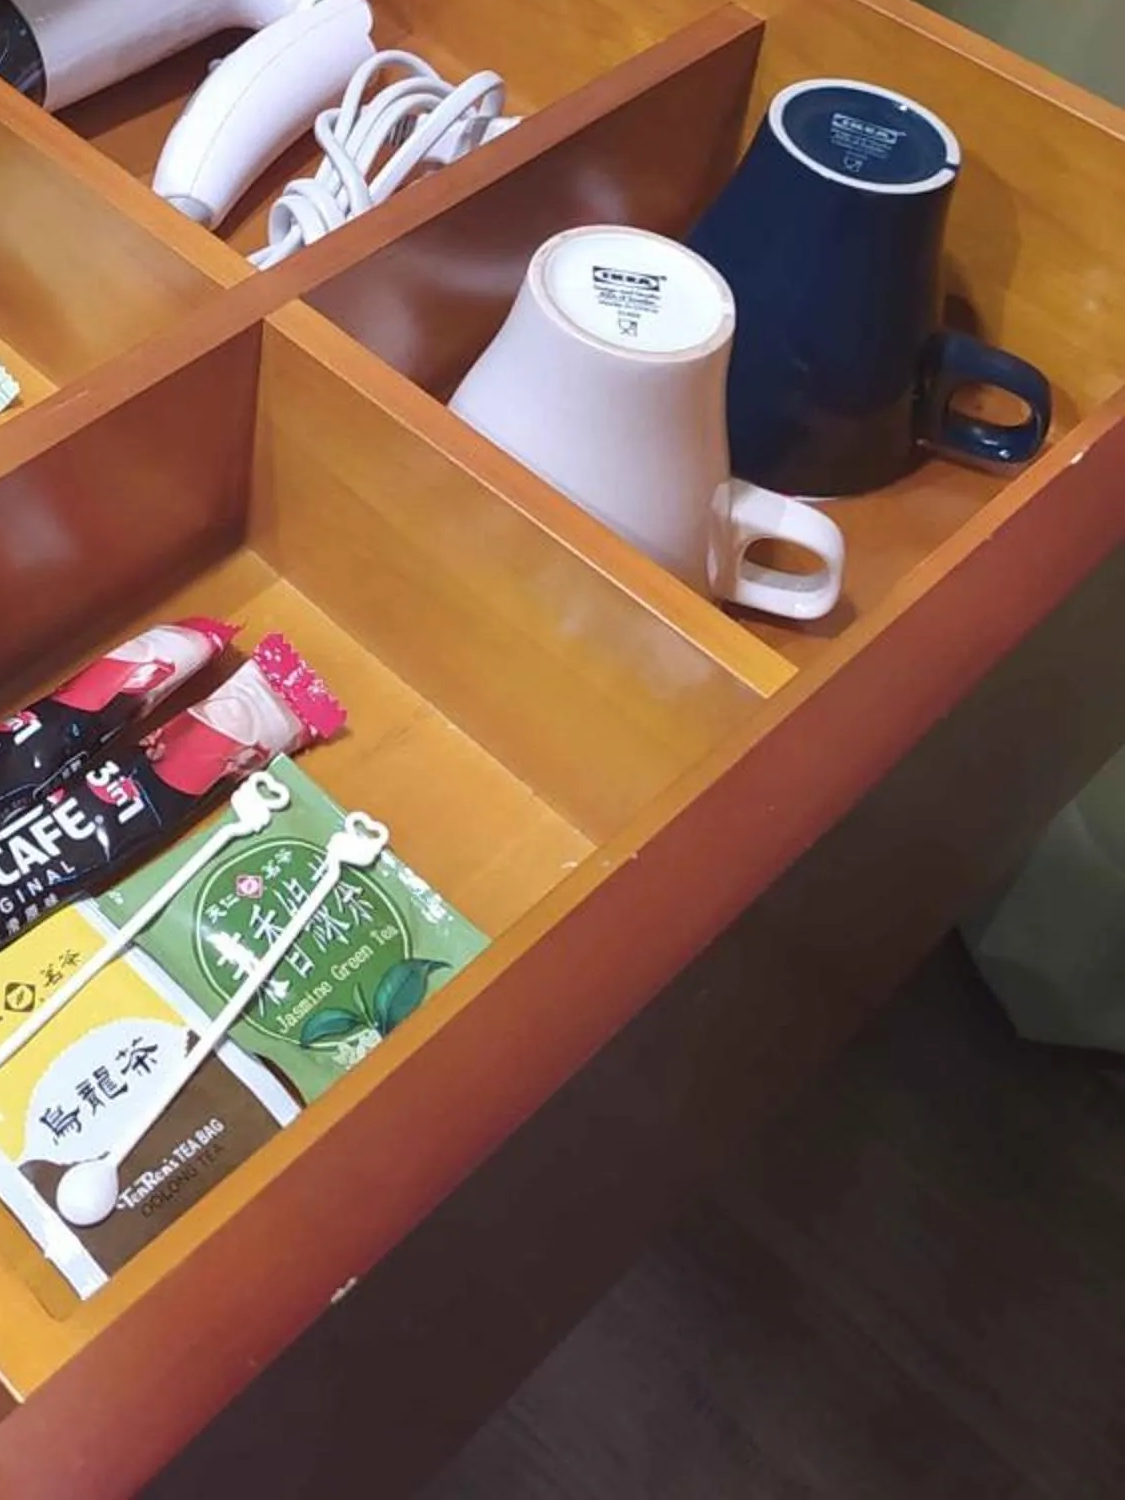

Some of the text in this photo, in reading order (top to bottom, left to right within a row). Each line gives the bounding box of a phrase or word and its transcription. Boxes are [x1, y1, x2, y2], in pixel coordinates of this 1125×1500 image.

[275, 922, 401, 1036] Jasmine Green Tea
[40, 1038, 162, 1146] 烏龍茶
[171, 1136, 203, 1164] TEA
[194, 1117, 226, 1146] BAG
[197, 1141, 225, 1168] TEA
